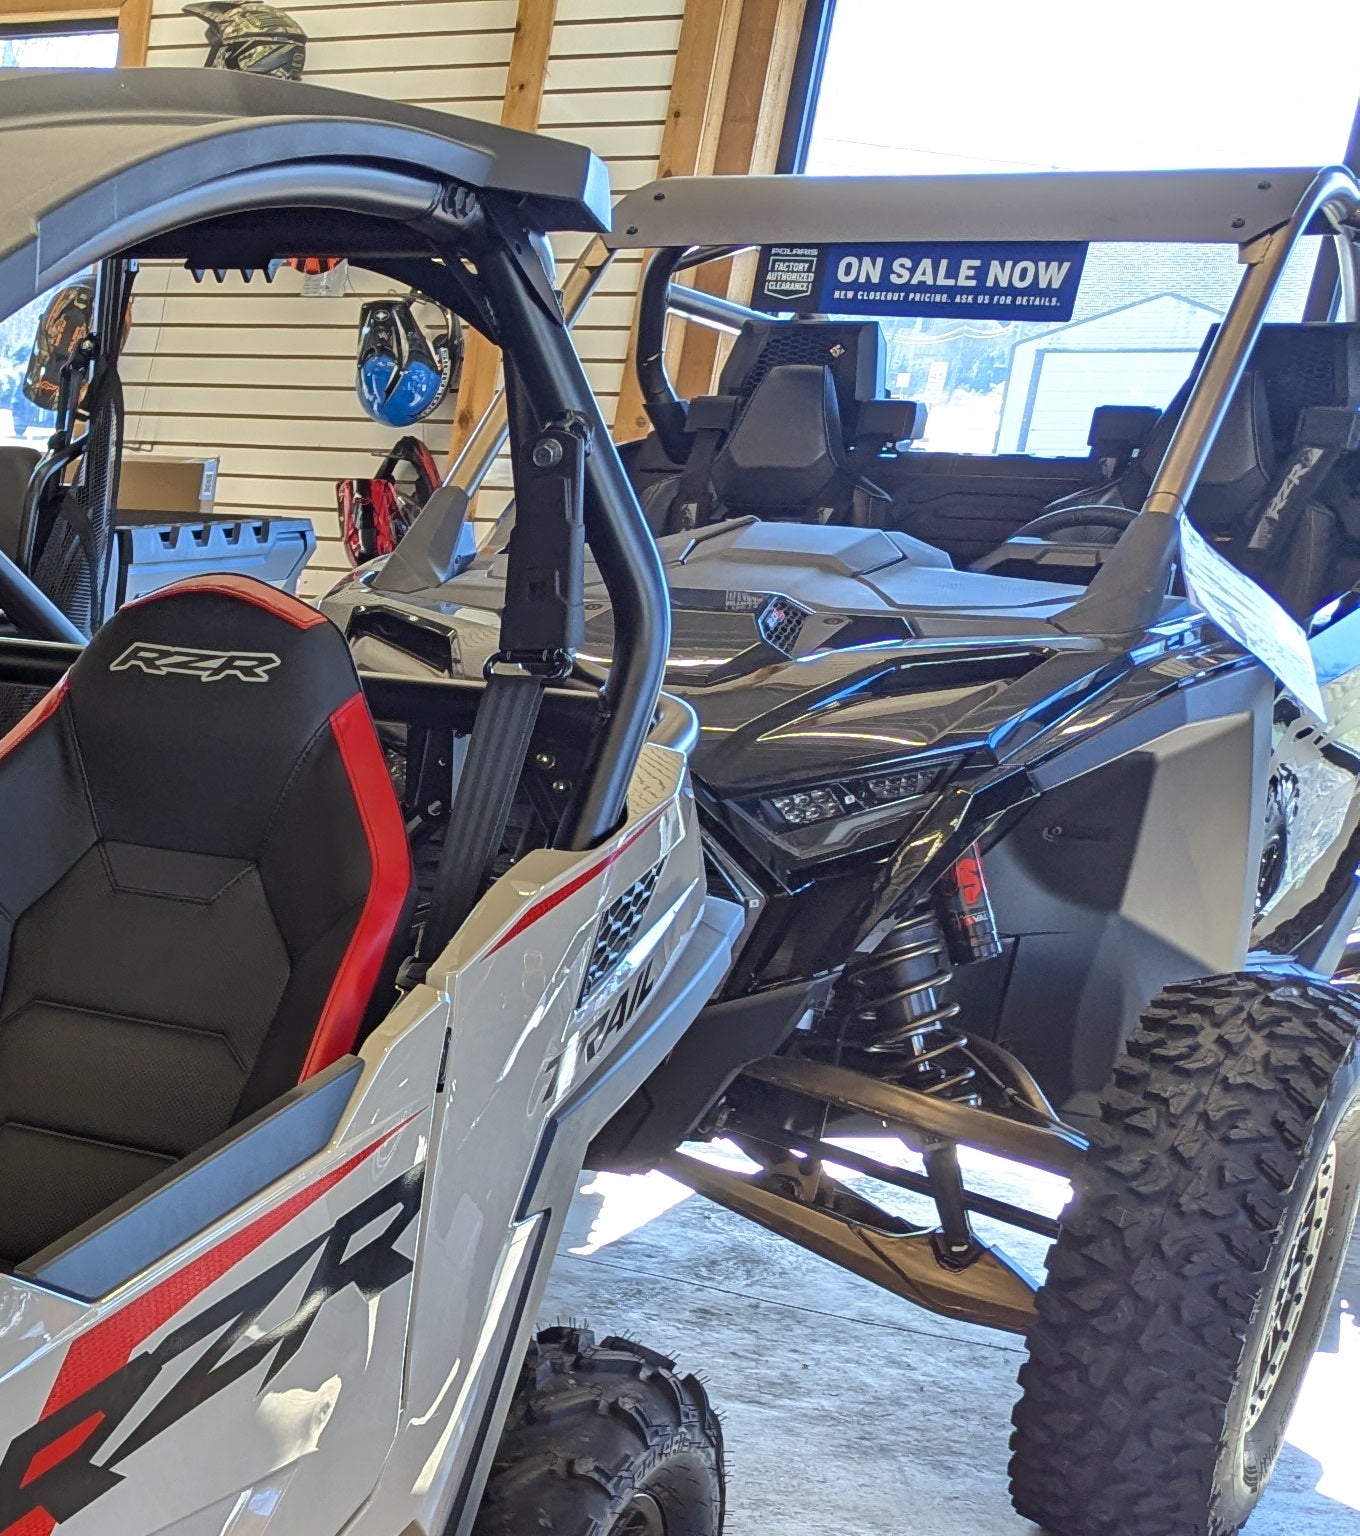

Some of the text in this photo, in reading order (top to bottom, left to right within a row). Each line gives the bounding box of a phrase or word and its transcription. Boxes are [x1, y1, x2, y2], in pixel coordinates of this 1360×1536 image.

[766, 272, 814, 281] AUTHORIZED
[774, 262, 809, 272] FACTORY
[837, 256, 1071, 289] ON SALE NOW
[769, 281, 808, 290] CLEARANCE
[833, 290, 1060, 306] NEW CLOSEOUT PRICING. ASK US FOR DETAILS.
[1264, 463, 1310, 521] RZR
[110, 641, 281, 682] RZR
[542, 957, 655, 1104] TRAIL
